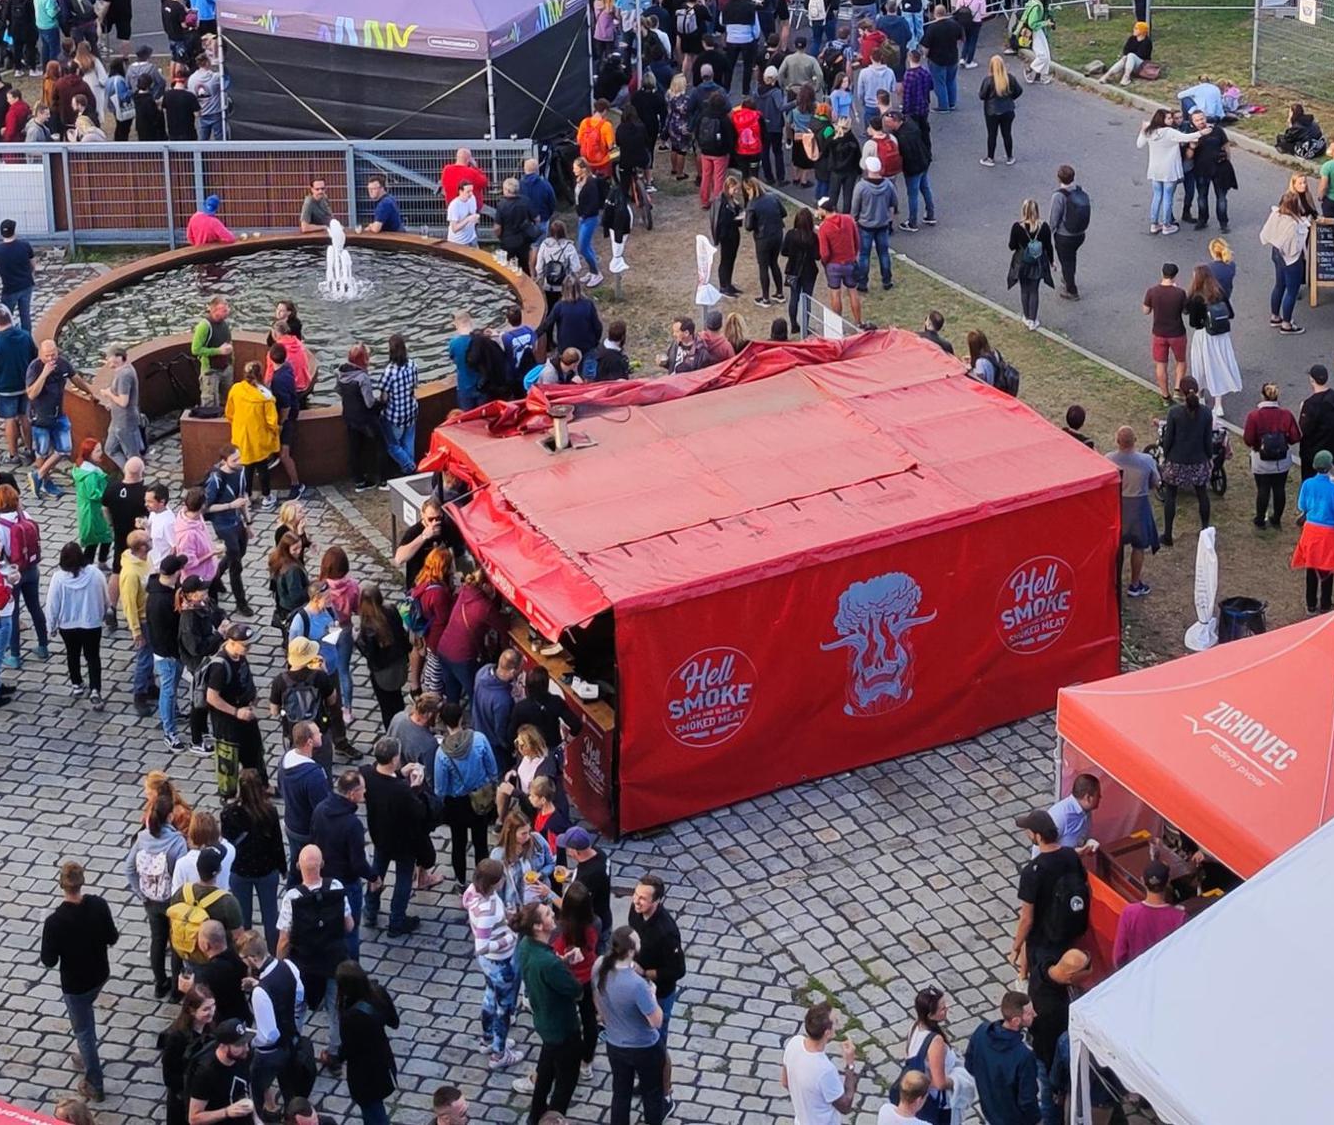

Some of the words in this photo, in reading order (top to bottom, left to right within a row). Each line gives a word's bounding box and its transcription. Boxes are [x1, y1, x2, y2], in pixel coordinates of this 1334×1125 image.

[1010, 563, 1059, 602] Hell
[1001, 590, 1072, 630] SMOKE
[1041, 616, 1066, 631] MEAT
[679, 654, 735, 693] Hell
[668, 683, 753, 720] SMOKE
[675, 716, 716, 734] SMOKED
[718, 709, 745, 724] MEAT
[1202, 700, 1298, 771] ZICHOVEC
